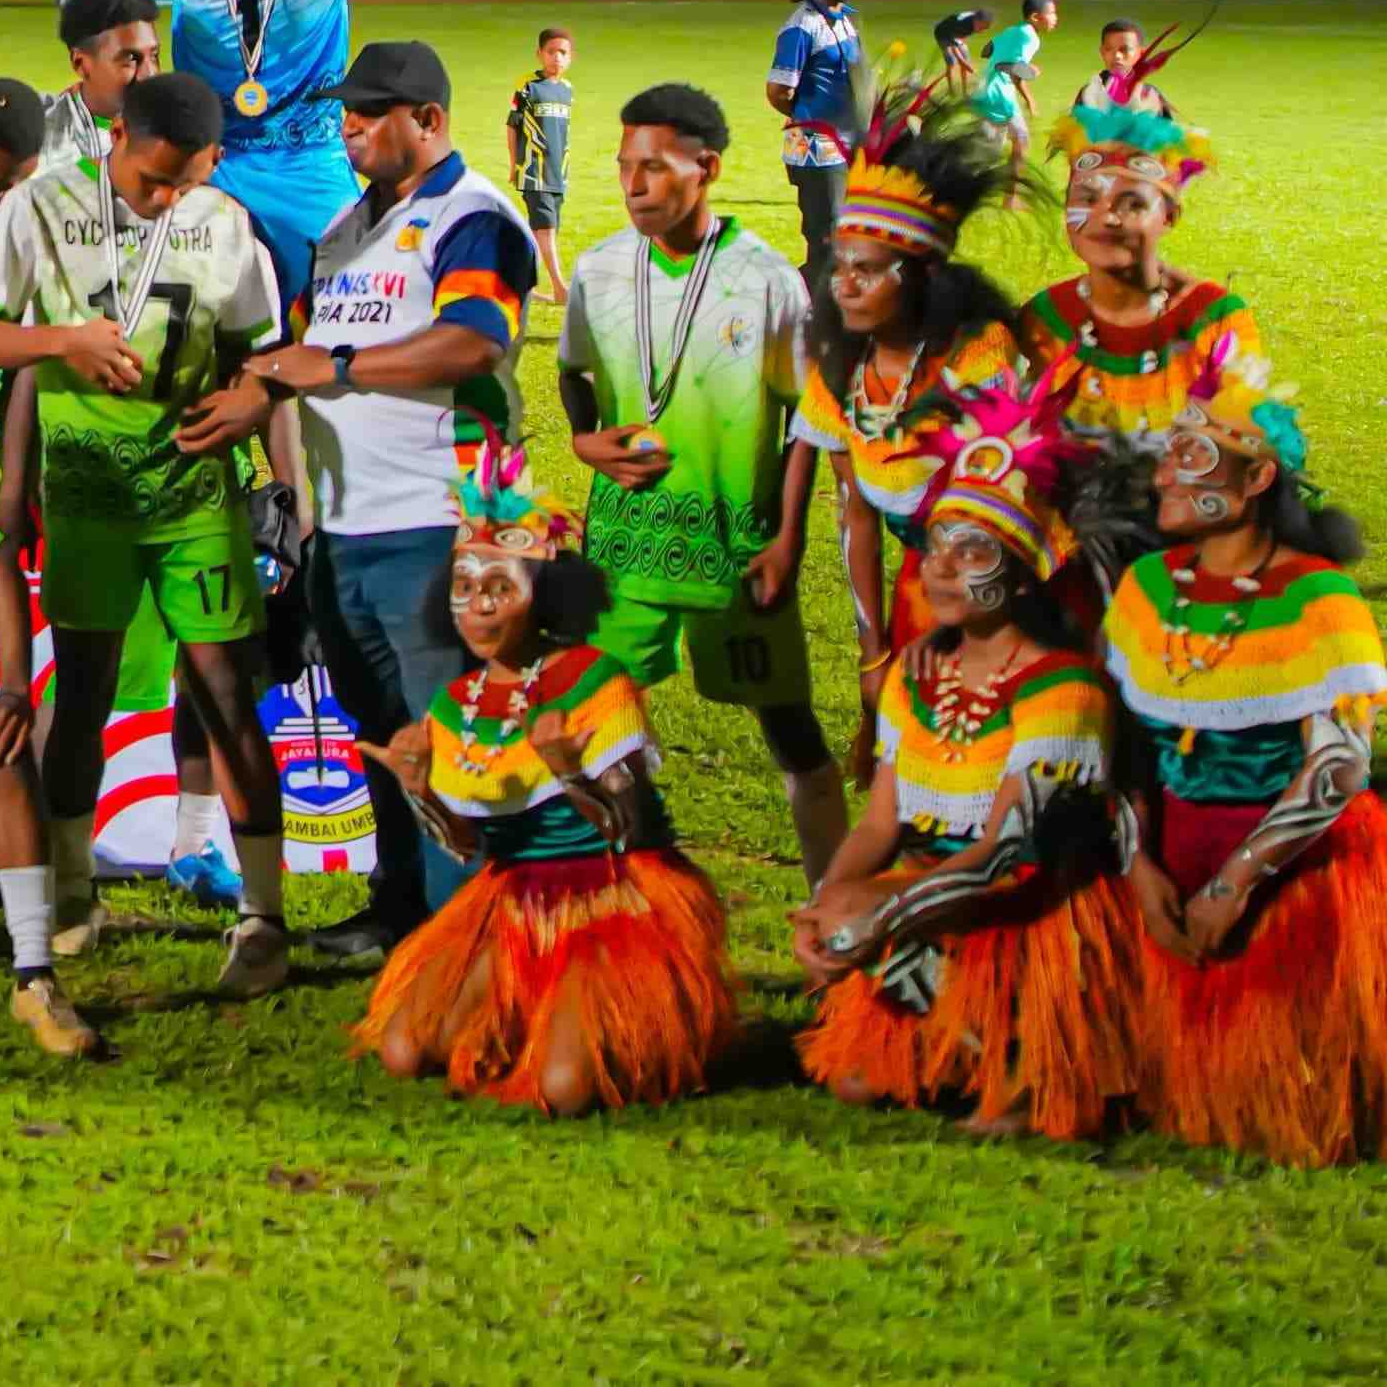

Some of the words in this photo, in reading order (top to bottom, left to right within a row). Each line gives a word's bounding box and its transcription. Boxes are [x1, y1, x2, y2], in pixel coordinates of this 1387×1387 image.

[169, 225, 213, 253] UTRA
[347, 300, 392, 325] 2021
[190, 565, 231, 616] 17
[725, 632, 771, 686] 10
[280, 747, 351, 762] JAYAURA
[282, 818, 337, 839] AMBAI
